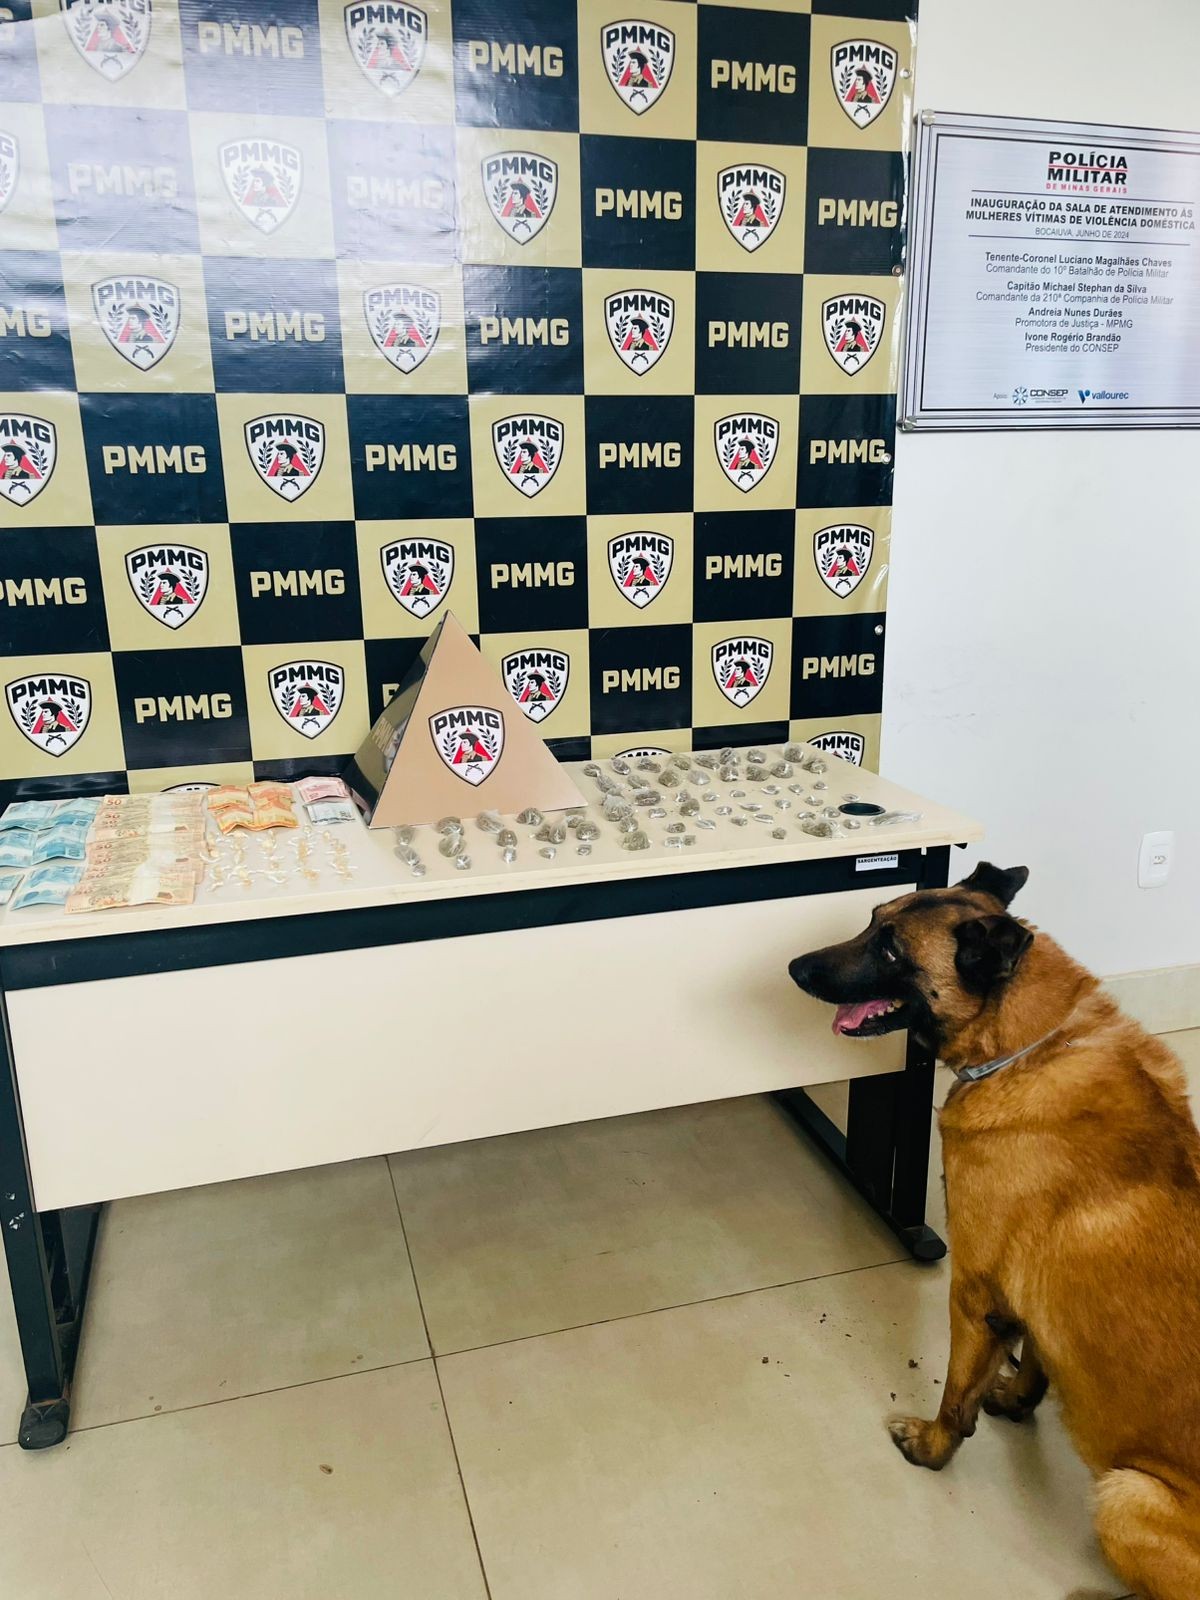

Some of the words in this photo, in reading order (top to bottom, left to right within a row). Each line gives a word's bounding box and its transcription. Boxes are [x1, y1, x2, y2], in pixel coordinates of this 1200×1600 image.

[349, 8, 422, 33] PMMG
[200, 22, 304, 58] PMMG
[606, 26, 671, 53] PMMG
[468, 41, 564, 77] PMMG
[835, 43, 894, 70] PMMG
[711, 60, 796, 93] PMMG
[223, 142, 298, 169] PMMG
[1049, 151, 1128, 169] POLÍCIA
[68, 164, 178, 197] PMMG
[486, 160, 553, 183] PMMG
[1047, 168, 1127, 185] MILITAR
[346, 175, 443, 208] PMMG
[722, 172, 781, 195] PMMG
[1061, 184, 1090, 192] MINAS
[1093, 185, 1128, 194] GERAIS
[595, 189, 682, 220] PMMG
[818, 198, 898, 228] PMMG
[971, 198, 1046, 212] INAUGURAÇÃO
[1049, 202, 1063, 211] DA
[1065, 203, 1091, 213] SALA
[1094, 205, 1107, 214] DE
[1109, 206, 1178, 217] ATENDIMENTO
[966, 210, 1022, 222] MULHERES
[1025, 212, 1066, 224] VÍTIMAS
[1069, 215, 1082, 225] DE
[1085, 214, 1138, 227] VIOLÊNCIA
[1140, 217, 1195, 230] DOMÉSTICA
[1076, 229, 1100, 238] JUNHO
[1114, 231, 1129, 239] 2024
[985, 252, 1057, 263] Tenente-Coronel
[1059, 254, 1093, 265] Luciano
[1095, 256, 1140, 267] Magalhães
[1142, 258, 1172, 267] Chaves
[986, 263, 1038, 274] Comandante
[1040, 265, 1051, 274] do
[1069, 266, 1104, 276] Batalhão
[1105, 267, 1116, 277] de
[1118, 267, 1144, 277] Polícia
[1146, 268, 1169, 278] Militar
[98, 280, 174, 307] PMMG
[368, 288, 437, 309] PMMG
[976, 291, 1028, 301] Comandante
[1030, 292, 1041, 302] da
[1063, 294, 1108, 304] Companhia
[1110, 295, 1121, 304] de
[1122, 295, 1149, 304] Polícia
[1150, 296, 1174, 305] Militar
[1007, 281, 1040, 292] Capitão
[1043, 282, 1076, 291] Michael
[1078, 283, 1112, 293] Stephan
[1114, 284, 1125, 293] da
[1127, 284, 1147, 293] Silva
[609, 295, 670, 318] PMMG
[826, 300, 881, 321] PMMG
[1028, 307, 1062, 316] Andreia
[1064, 307, 1091, 317] Nunes
[1093, 308, 1123, 317] Durães
[224, 311, 326, 342] PMMG
[480, 317, 569, 346] PMMG
[708, 321, 789, 348] PMMG
[1015, 317, 1057, 327] Promotora
[1059, 318, 1069, 327] de
[1071, 319, 1099, 330] Justiça
[1106, 319, 1133, 328] MPMG
[1024, 332, 1048, 341] Ivone
[1050, 332, 1084, 343] Rogério
[1086, 333, 1121, 342] Brandão
[1025, 343, 1068, 352] Presidente
[1070, 343, 1080, 352] do
[1082, 343, 1119, 352] CONSEP
[1030, 389, 1068, 397] CONSEP
[1092, 389, 1129, 399] vallourec
[250, 419, 320, 443] PMMG
[498, 419, 559, 441] PMMG
[719, 417, 775, 438] PMMG
[102, 445, 206, 474] PMMG
[365, 444, 457, 471] PMMG
[600, 442, 681, 468] PMMG
[810, 439, 886, 464] PMMG
[385, 543, 449, 564] PMMG
[612, 536, 669, 557] PMMG
[818, 533, 870, 552] PMMG
[131, 549, 203, 573] PMMG
[706, 553, 782, 580] PMMG
[250, 569, 345, 597] PMMG
[491, 561, 574, 588] PMMG
[0, 577, 88, 606] MMG
[715, 641, 769, 659] PMMG
[273, 665, 340, 685] PMMG
[506, 655, 565, 675] PMMG
[802, 653, 875, 679] PMMG
[11, 678, 86, 699] PMMG
[603, 666, 680, 694] PMMG
[135, 693, 232, 724] PMMG
[434, 711, 500, 735] PMMG
